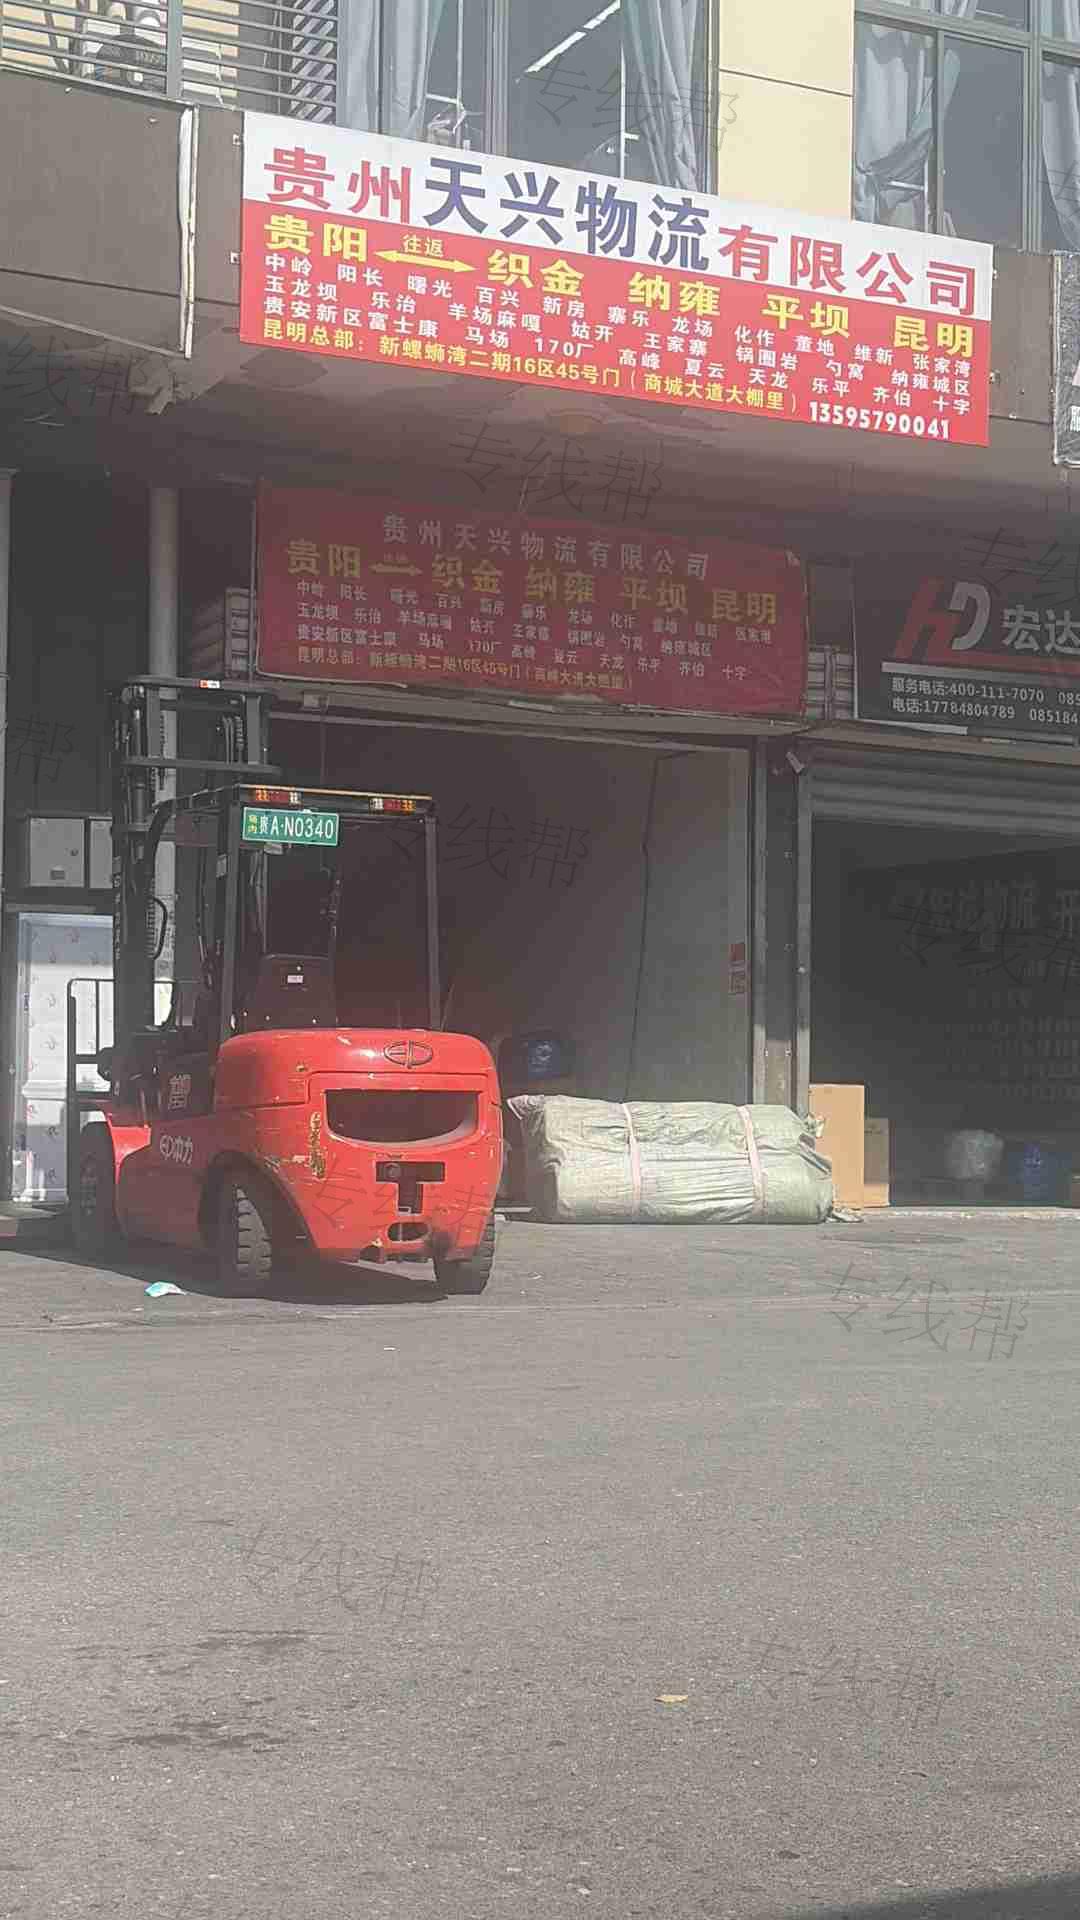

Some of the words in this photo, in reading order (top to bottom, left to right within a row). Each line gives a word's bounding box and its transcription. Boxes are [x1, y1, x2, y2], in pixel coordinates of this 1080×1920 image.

[264, 147, 976, 316] 贵州天兴物流有限公司
[264, 214, 368, 262] 贵阳
[487, 249, 585, 297] 织金
[628, 272, 721, 317] 纳雍
[762, 294, 850, 338] 平坝
[893, 315, 974, 357] 昆明
[264, 254, 313, 275] 中岭
[337, 264, 384, 288] 阳长
[475, 286, 520, 308] 百兴
[543, 296, 587, 319] 新房
[672, 316, 713, 338] 龙场
[735, 325, 776, 348] 化作
[854, 344, 894, 366] 维新
[912, 353, 972, 377] 张家湾
[264, 275, 338, 302] 玉龙坝
[371, 291, 417, 314] 乐治
[571, 321, 615, 343] 姑开
[891, 369, 971, 396] 纳雍城区
[264, 296, 439, 338] 贵安新区富士康
[465, 326, 509, 350] 马场
[534, 337, 594, 359] 170厂
[618, 348, 661, 370] 高峰
[685, 358, 726, 380] 夏云
[749, 368, 789, 389] 天龙
[811, 377, 850, 398] 乐平
[873, 386, 912, 408] 齐伯
[932, 395, 971, 416] 十字
[810, 401, 950, 439] 13595790041
[287, 538, 361, 579] 贵阳
[617, 576, 688, 616] 平坝
[711, 587, 778, 625] 昆明
[384, 513, 709, 580] 贵州天兴物流有限公司
[1001, 604, 1080, 654] 宏达
